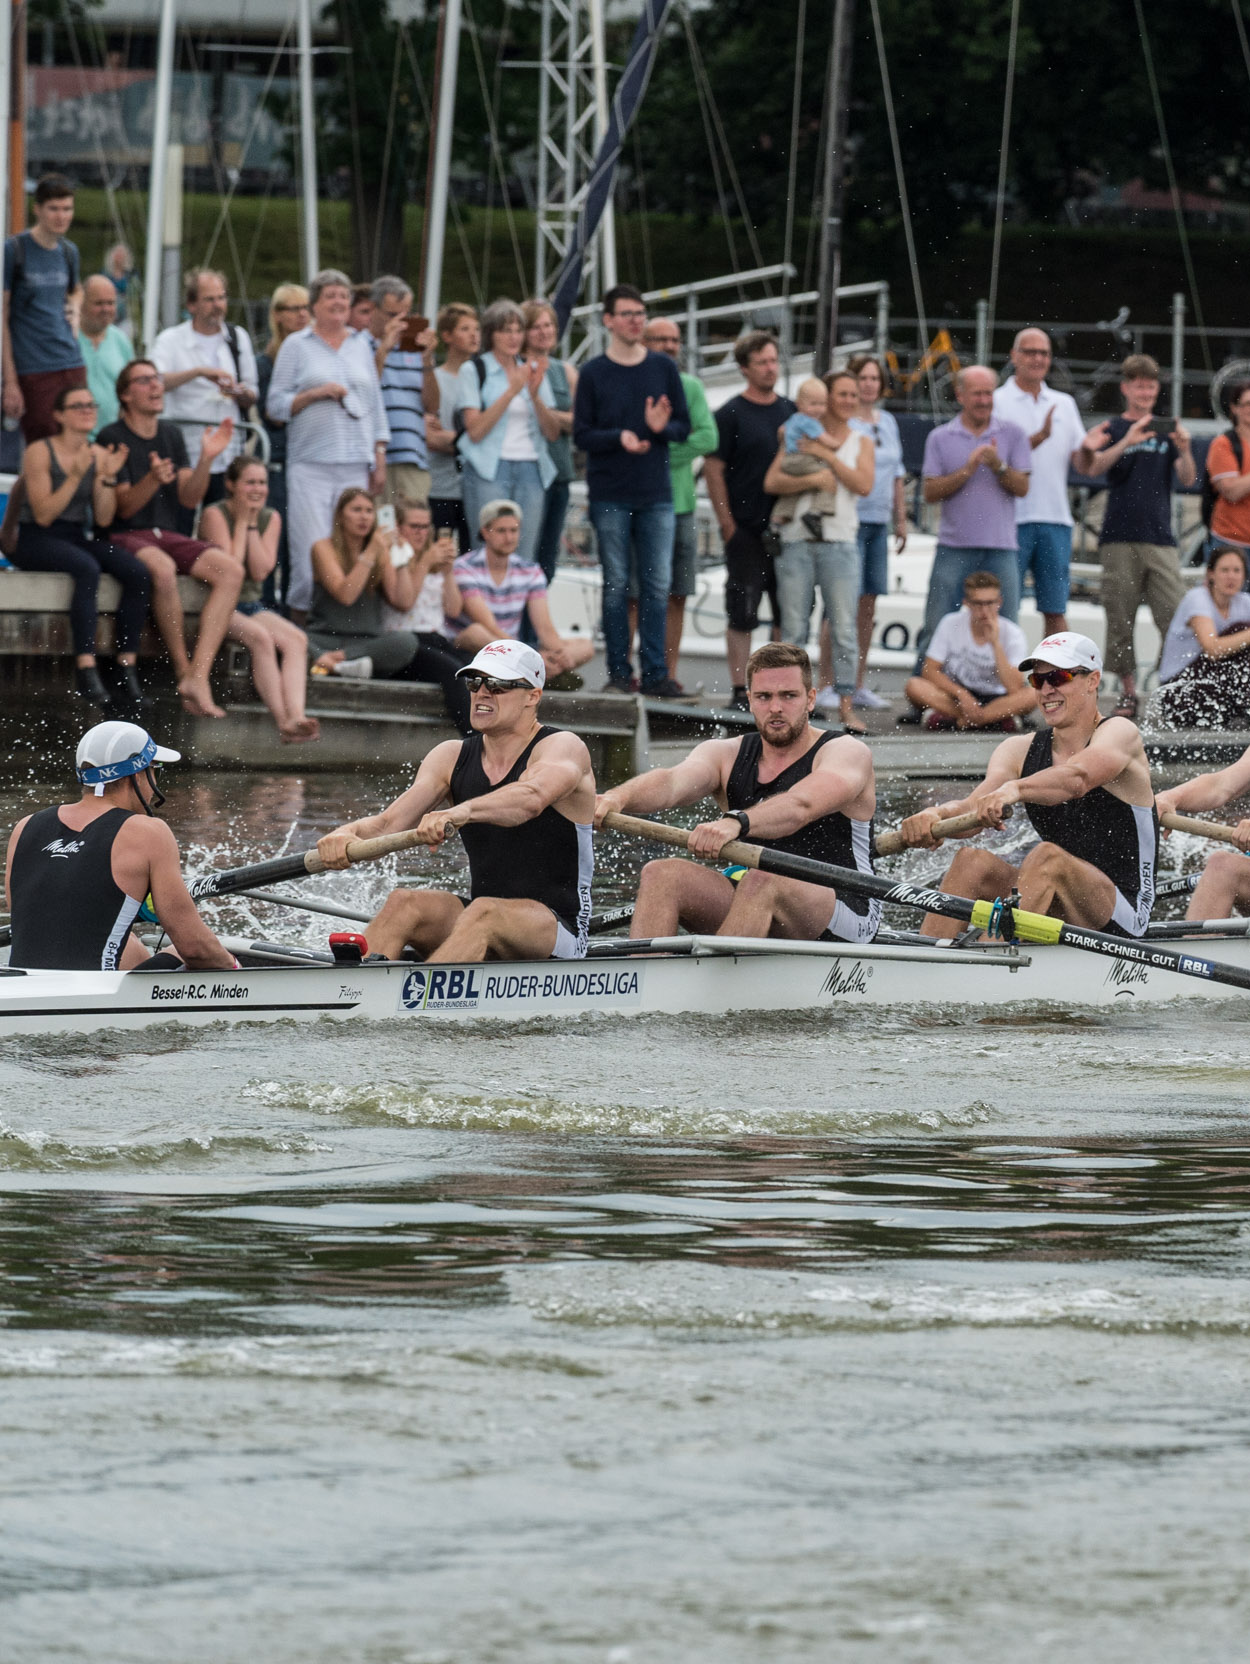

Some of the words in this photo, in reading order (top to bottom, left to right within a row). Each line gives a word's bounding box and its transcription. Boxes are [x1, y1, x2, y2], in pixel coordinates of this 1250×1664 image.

[98, 766, 119, 779] NK
[132, 756, 147, 771] NK
[884, 883, 944, 911] Melitta
[1064, 932, 1100, 949] STARK.
[1101, 941, 1150, 962] SCHNELL.
[1151, 954, 1176, 968] GUT.
[1182, 959, 1211, 975] RBL
[427, 969, 480, 1000] RBL
[485, 972, 639, 999] RUDER-BUNDESLIGA
[818, 957, 868, 997] Melitta
[151, 984, 207, 1000] Bessel-R.C.
[210, 984, 249, 999] Minden
[426, 999, 478, 1009] RUDER-BUNDESLIGA
